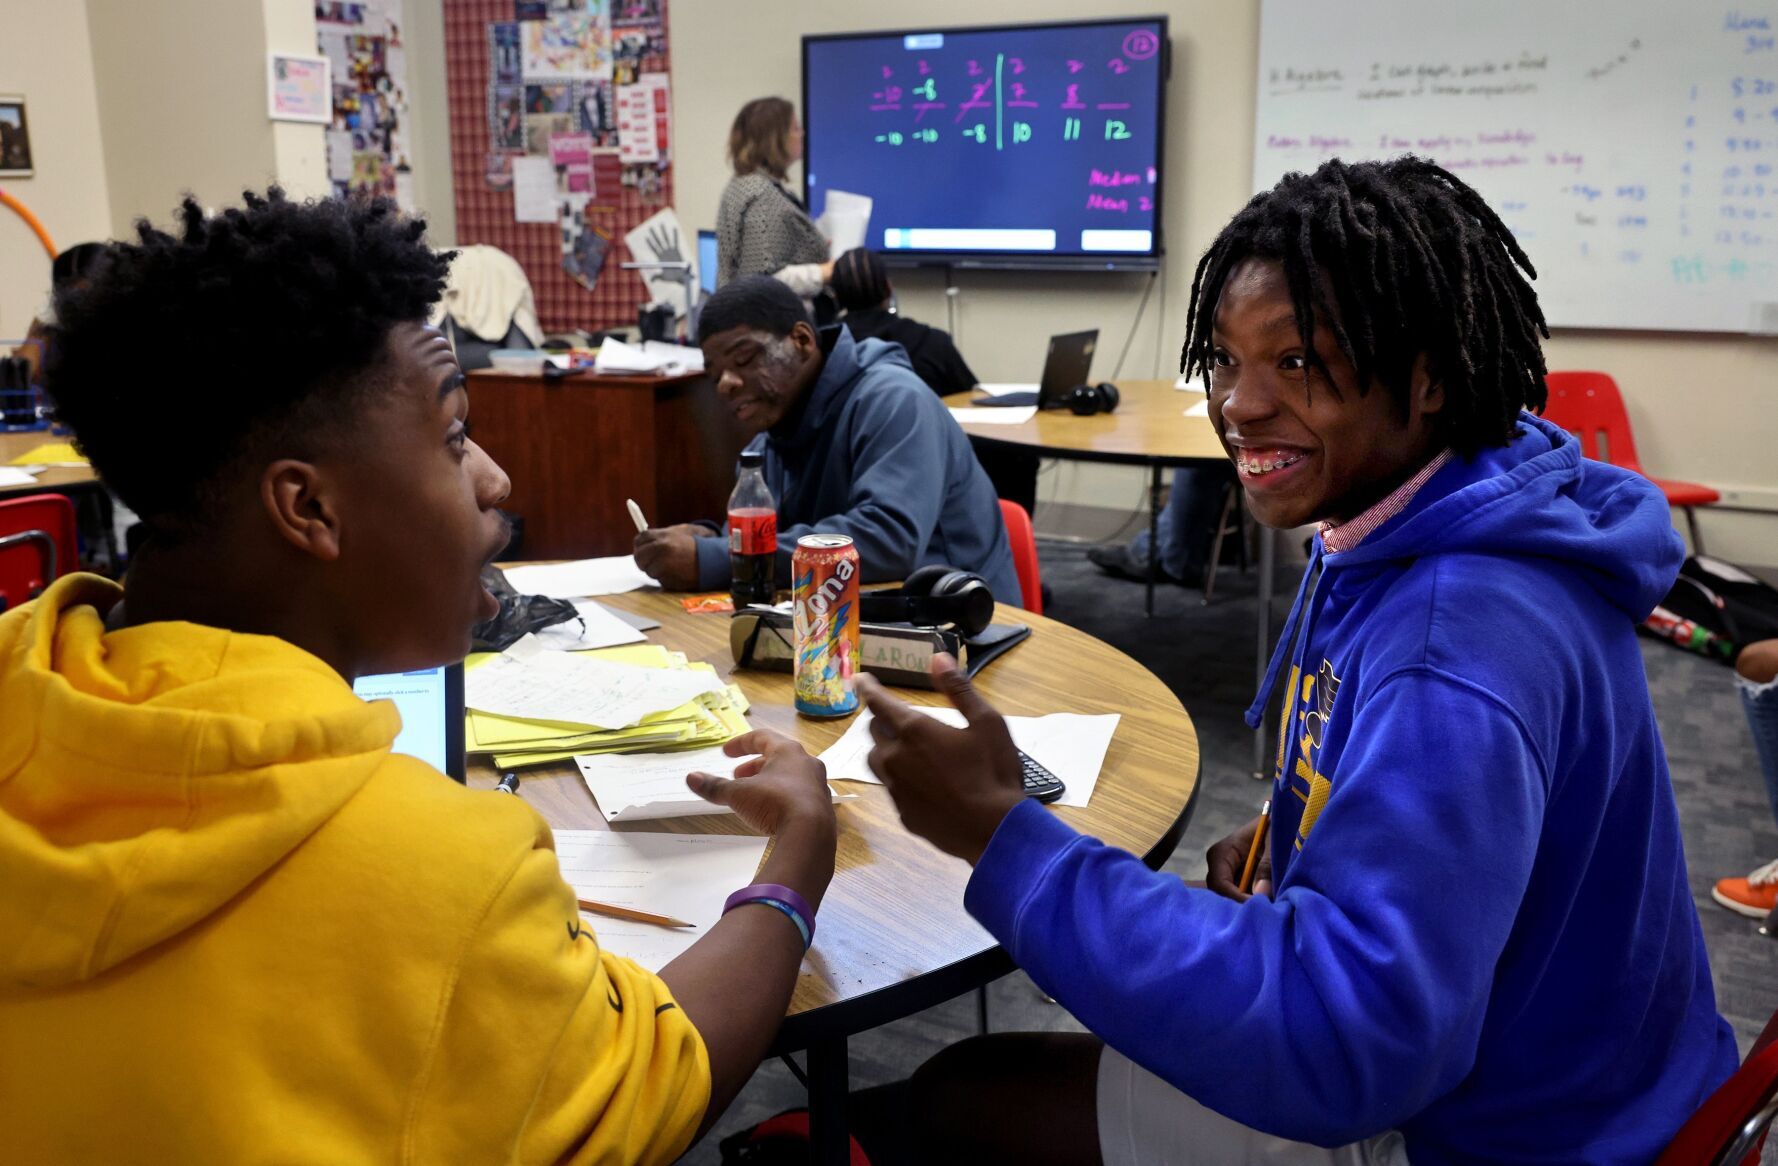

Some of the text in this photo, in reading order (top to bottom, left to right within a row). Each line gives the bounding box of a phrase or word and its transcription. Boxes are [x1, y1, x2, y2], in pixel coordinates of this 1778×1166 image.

[911, 128, 939, 144] -10
[962, 123, 987, 144] -8
[1013, 121, 1032, 144] 10
[1064, 117, 1081, 141] 11
[1104, 119, 1132, 140] 12
